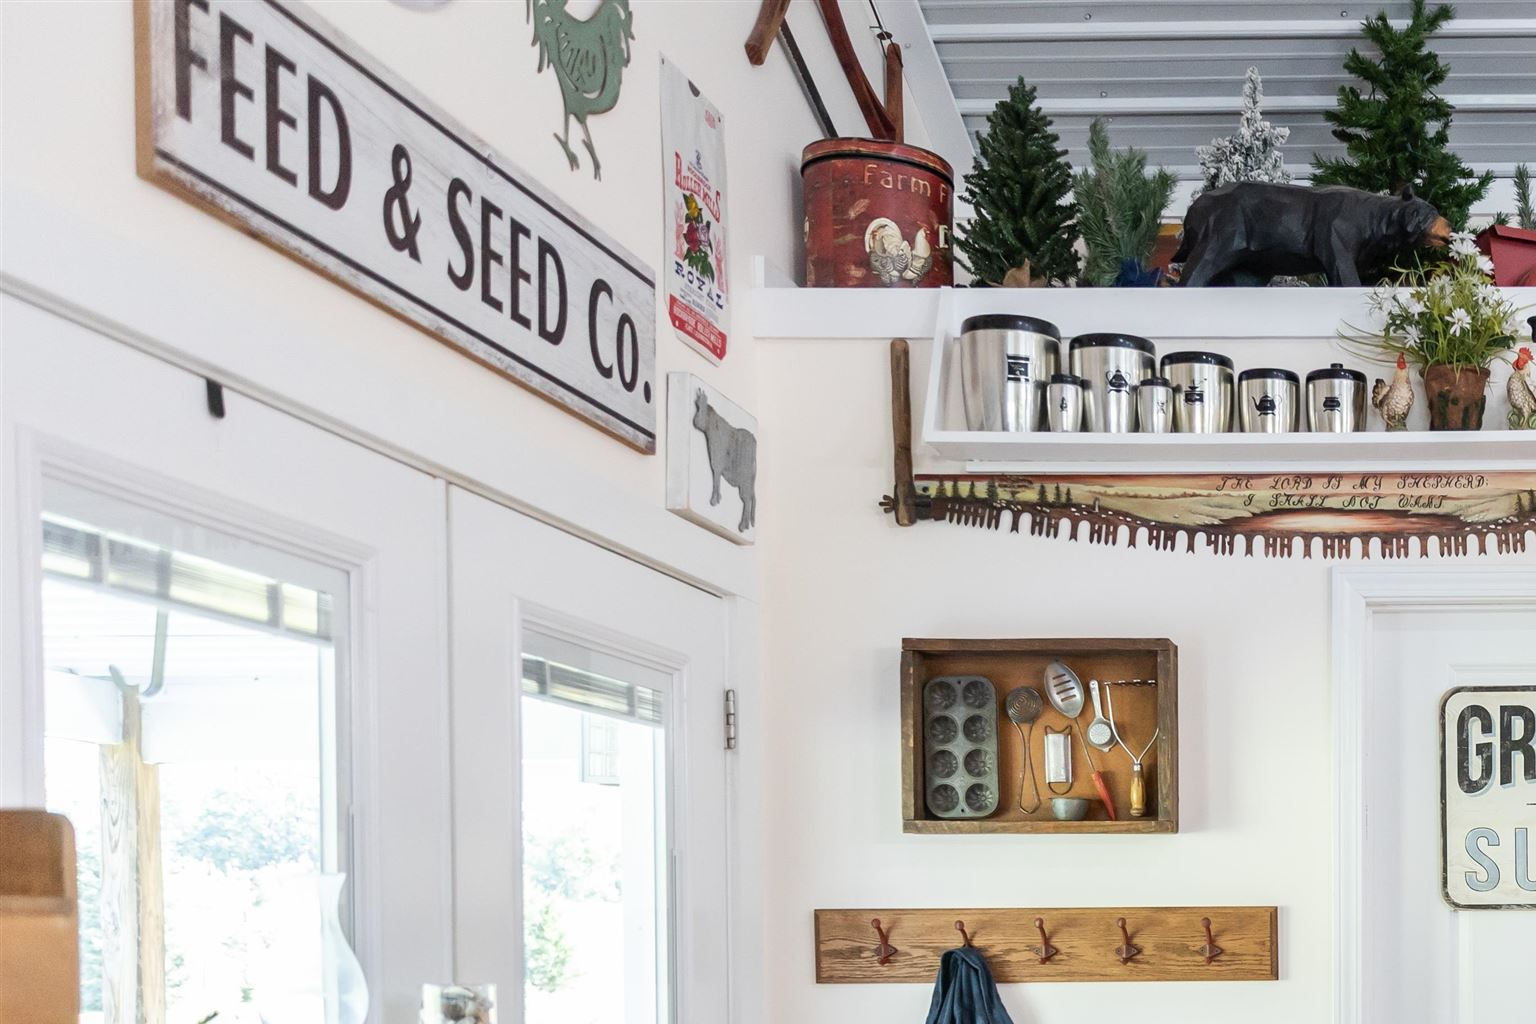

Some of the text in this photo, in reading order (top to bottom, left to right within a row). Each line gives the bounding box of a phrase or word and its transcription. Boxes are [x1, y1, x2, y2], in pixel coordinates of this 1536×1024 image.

[864, 164, 931, 198] Farm
[174, 0, 651, 403] FEED & SEED Co.
[674, 260, 724, 310] ROYAL
[1215, 476, 1253, 491] THE
[1269, 475, 1313, 490] LORD
[1322, 474, 1343, 489] IS
[1352, 475, 1382, 491] MY
[1243, 492, 1447, 509] I SHALL NOT WANT
